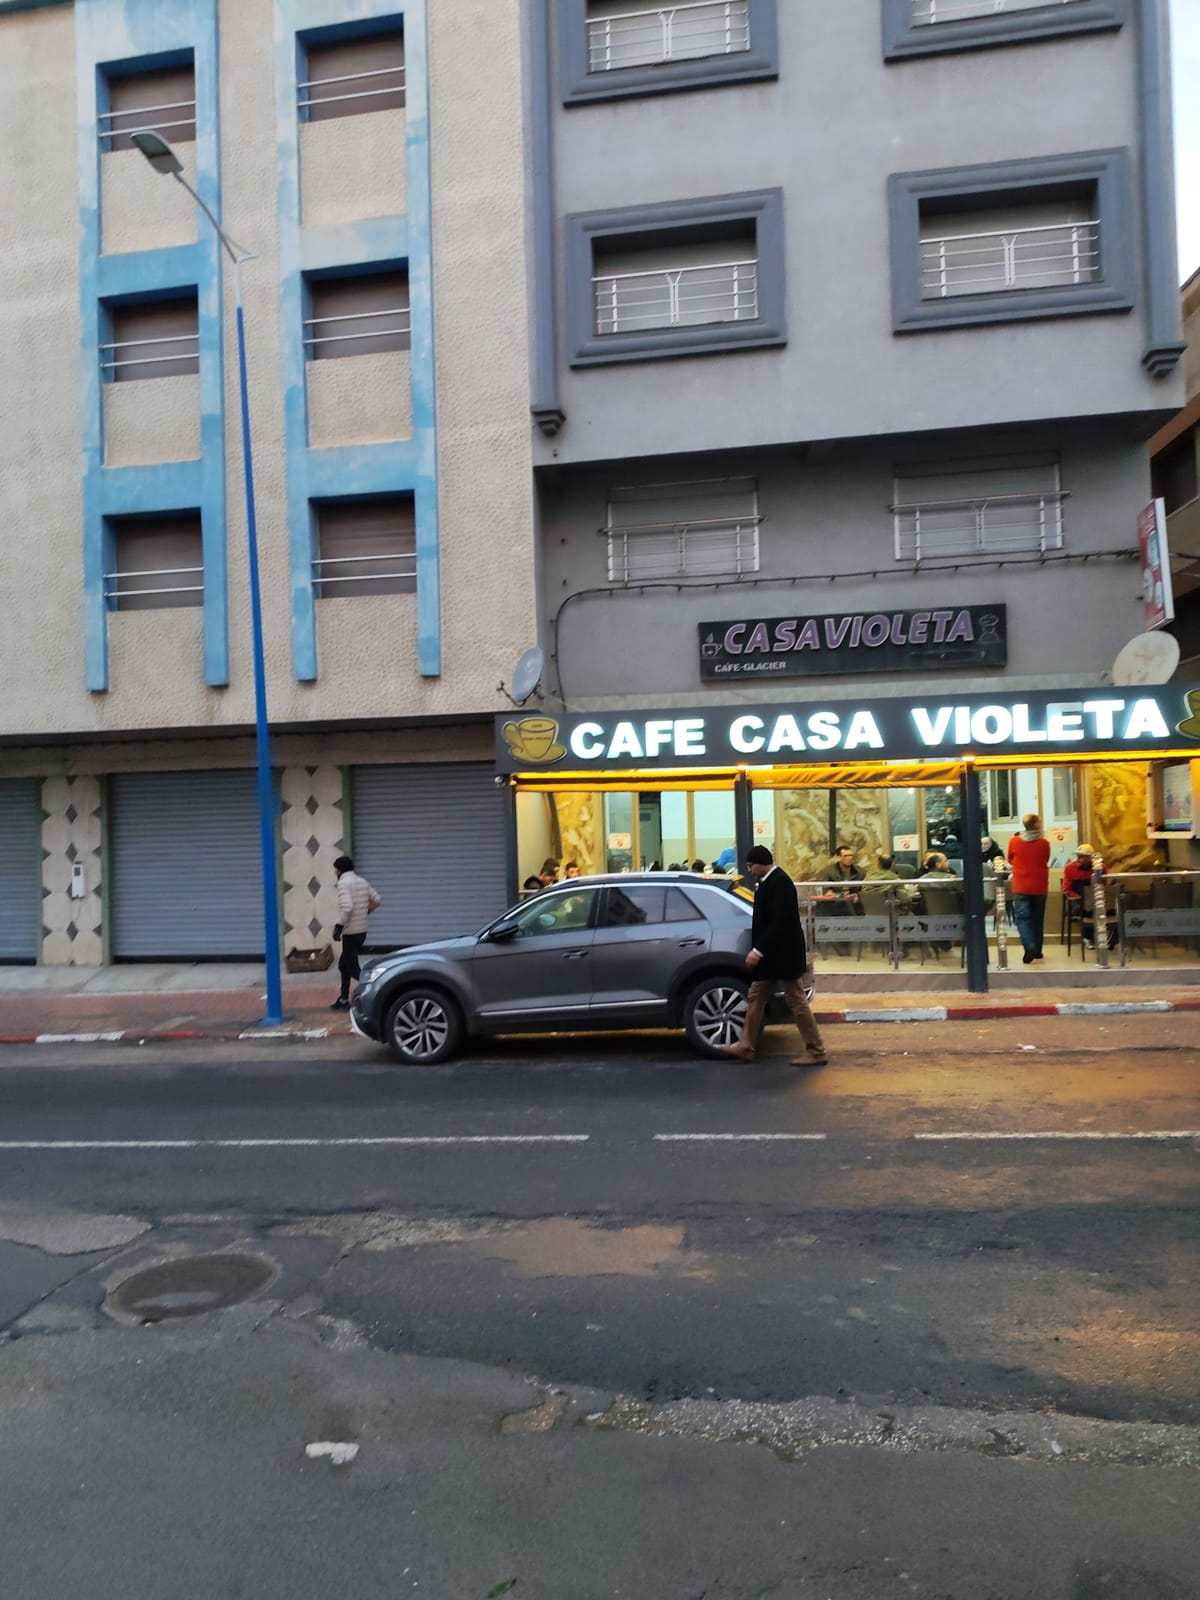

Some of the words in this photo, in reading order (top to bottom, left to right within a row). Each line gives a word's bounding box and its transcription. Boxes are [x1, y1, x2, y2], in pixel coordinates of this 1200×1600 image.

[570, 718, 706, 760] CAFE
[729, 711, 884, 754] CASA
[911, 698, 1170, 746] VIOLETA
